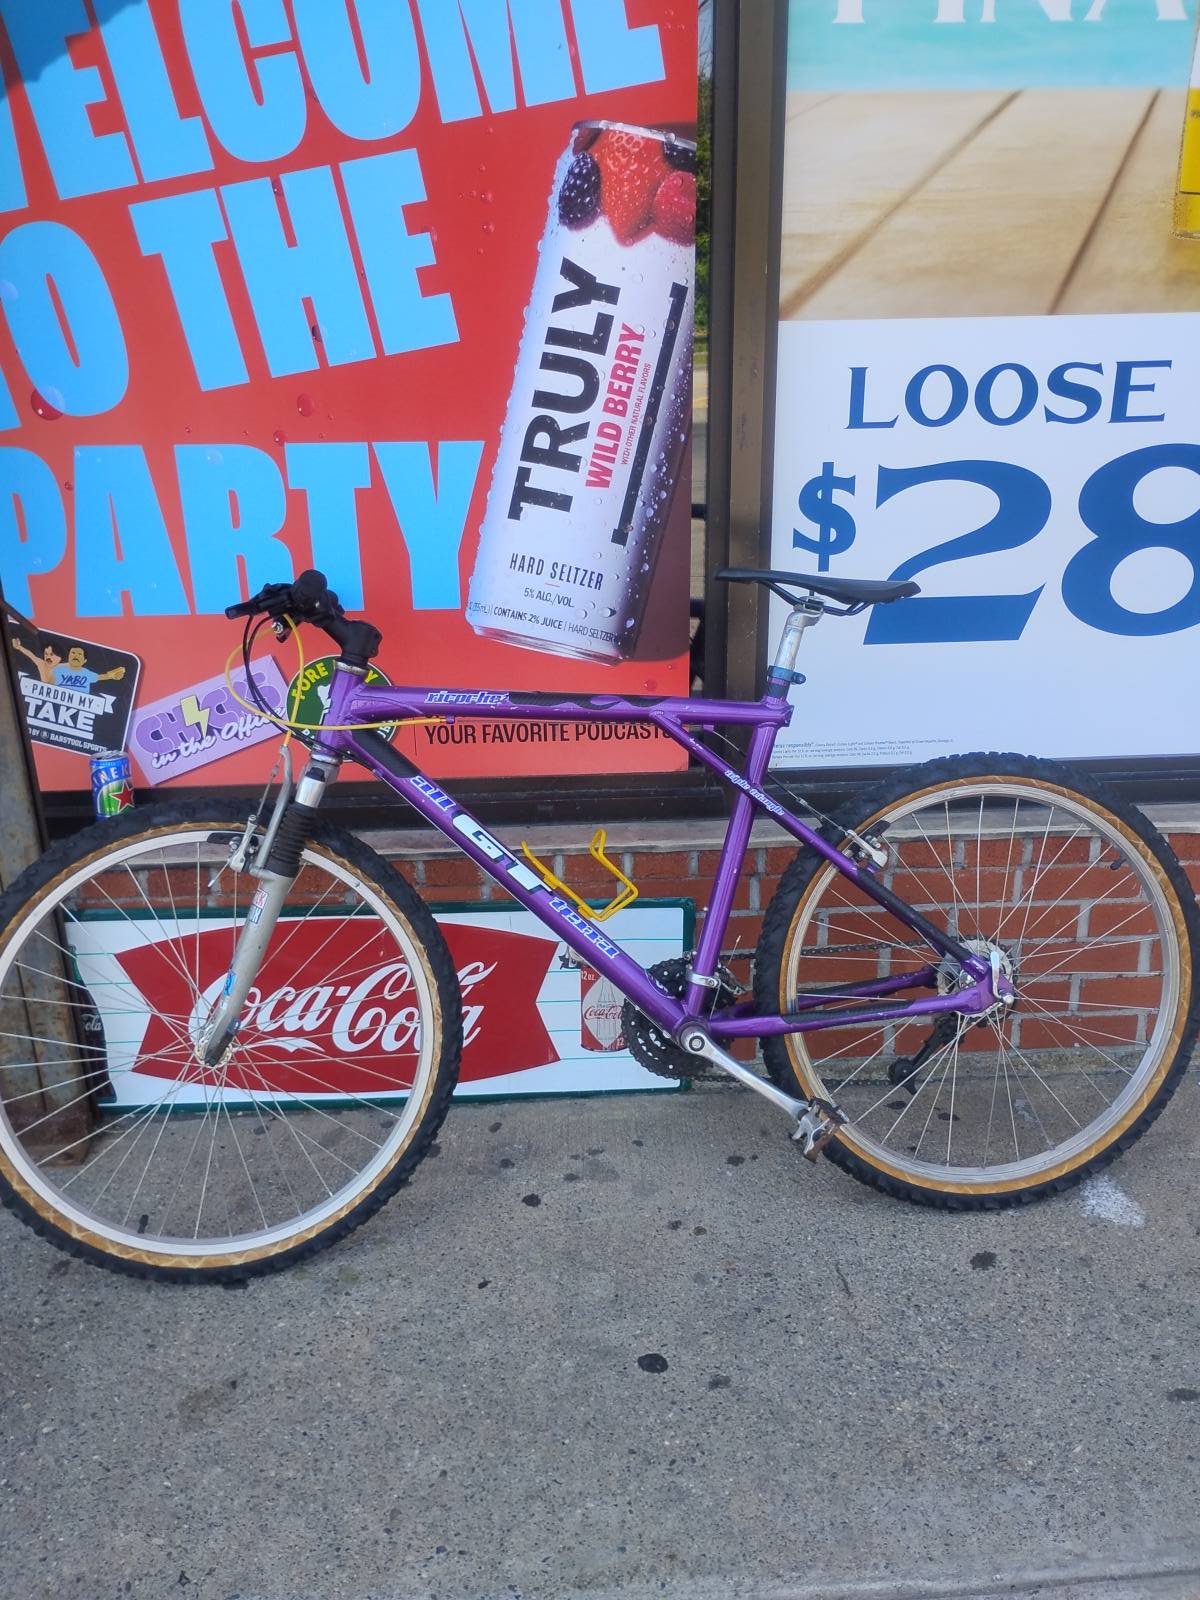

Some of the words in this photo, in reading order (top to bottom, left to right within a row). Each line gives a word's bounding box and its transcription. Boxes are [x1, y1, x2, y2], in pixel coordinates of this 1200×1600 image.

[128, 147, 461, 391] THE
[507, 256, 622, 521] TRULY
[602, 322, 646, 418] BERRY
[625, 425, 637, 448] OTHER
[631, 394, 644, 425] NATURAL
[639, 363, 652, 393] FLAVORS
[844, 359, 1173, 430] LOOSE
[585, 421, 622, 490] WILD
[0, 440, 485, 619] PARTY
[509, 553, 545, 576] HARD
[549, 561, 604, 591] SELTZER
[523, 587, 535, 599] 5%
[493, 606, 527, 622] CONTAINS
[528, 613, 540, 625] 2%
[540, 617, 563, 630] JUICE
[568, 621, 588, 636] HARD
[588, 626, 614, 643] SELTZER
[31, 683, 74, 704] PARDON
[78, 696, 94, 709] MY
[60, 674, 87, 686] YABO
[24, 696, 96, 732] TAKE
[424, 724, 477, 744] YOUR
[482, 722, 571, 743] FAVORITE
[49, 732, 84, 749] BARSTOOL
[151, 752, 177, 769] in
[176, 732, 216, 758] the
[452, 812, 553, 892] GT
